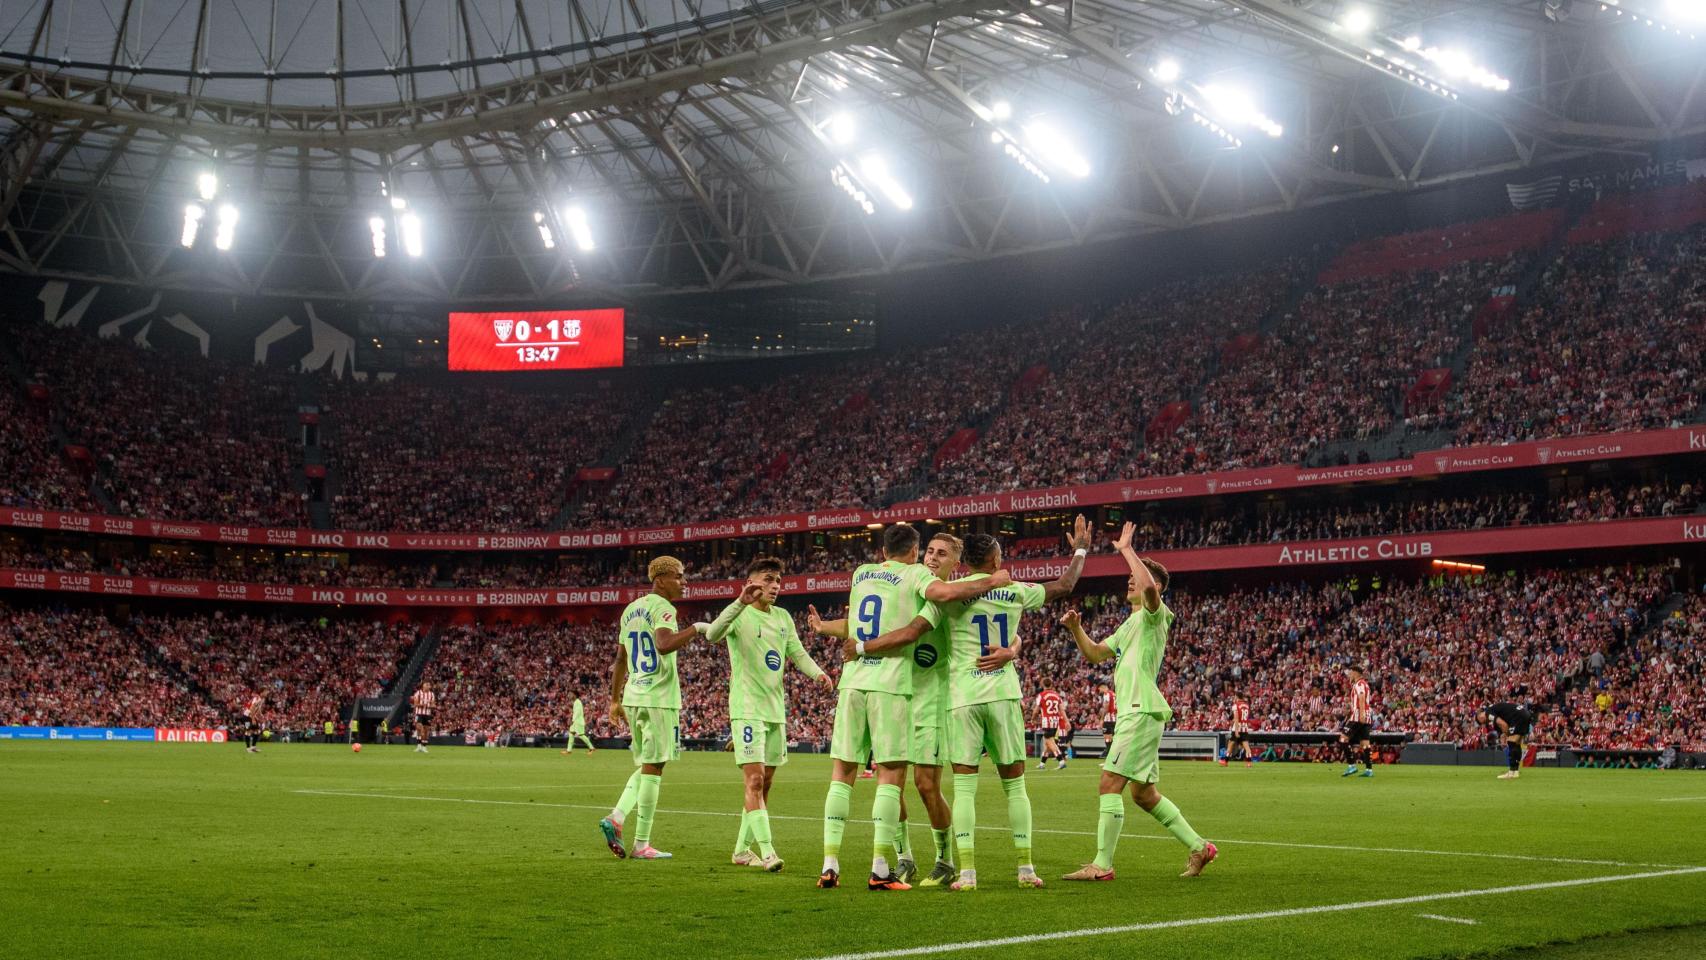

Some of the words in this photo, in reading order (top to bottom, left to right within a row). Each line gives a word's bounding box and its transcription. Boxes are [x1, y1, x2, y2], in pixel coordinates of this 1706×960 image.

[515, 320, 531, 341] 0
[546, 319, 559, 340] 1
[516, 347, 560, 362] 13:47
[1555, 447, 1595, 457] ATHLETIC
[1597, 445, 1622, 454] CLUB
[1452, 457, 1489, 467] ATHLETIC
[1492, 455, 1514, 464] CLUB
[1221, 479, 1252, 489] ATHLETIC
[1254, 478, 1272, 486] CLUB
[1134, 488, 1164, 496] ATHLETIC
[1165, 486, 1183, 494] CLUB
[938, 498, 1000, 516] kutxabank
[1011, 490, 1078, 510] kutxabank
[12, 512, 43, 522] CLUB
[884, 507, 929, 518] CASTORE
[59, 515, 90, 526] CLUB
[104, 519, 133, 530] CLUB
[817, 513, 861, 526] athleticclub
[59, 524, 89, 532] ATHLETIC
[749, 519, 798, 532] @athletic_eus
[219, 527, 248, 536] CLUB
[267, 529, 296, 539] CLUB
[638, 531, 675, 541] FUNDAZIOA
[311, 533, 344, 547] IMQ
[356, 535, 389, 548] IMQ
[490, 537, 549, 548] B2BINPAY
[571, 535, 590, 546] BM
[603, 533, 622, 545] BM
[1279, 546, 1369, 564] ATHLETIC
[1377, 539, 1432, 558] CLUB
[1011, 562, 1071, 579] kutxaban
[14, 572, 46, 583] CLUB
[59, 575, 90, 586] CLUB
[103, 578, 133, 588] CLUB
[815, 576, 851, 590] athleticcl
[15, 581, 45, 589] ATHLETIC
[60, 584, 90, 592] ATHLETIC
[217, 584, 246, 594] CLUB
[217, 592, 246, 600] ATHLETIC
[264, 587, 294, 596] CLUB
[569, 592, 588, 603] BM
[601, 591, 620, 602] BM
[312, 591, 345, 604] IMQ
[355, 591, 388, 604] IMQ
[489, 593, 548, 604] B2BINPAY
[856, 594, 882, 641] 9
[971, 612, 1009, 657] 11
[628, 631, 658, 673] 19
[1046, 699, 1059, 714] 23
[158, 730, 208, 742] LALIGA
[743, 725, 753, 744] 8
